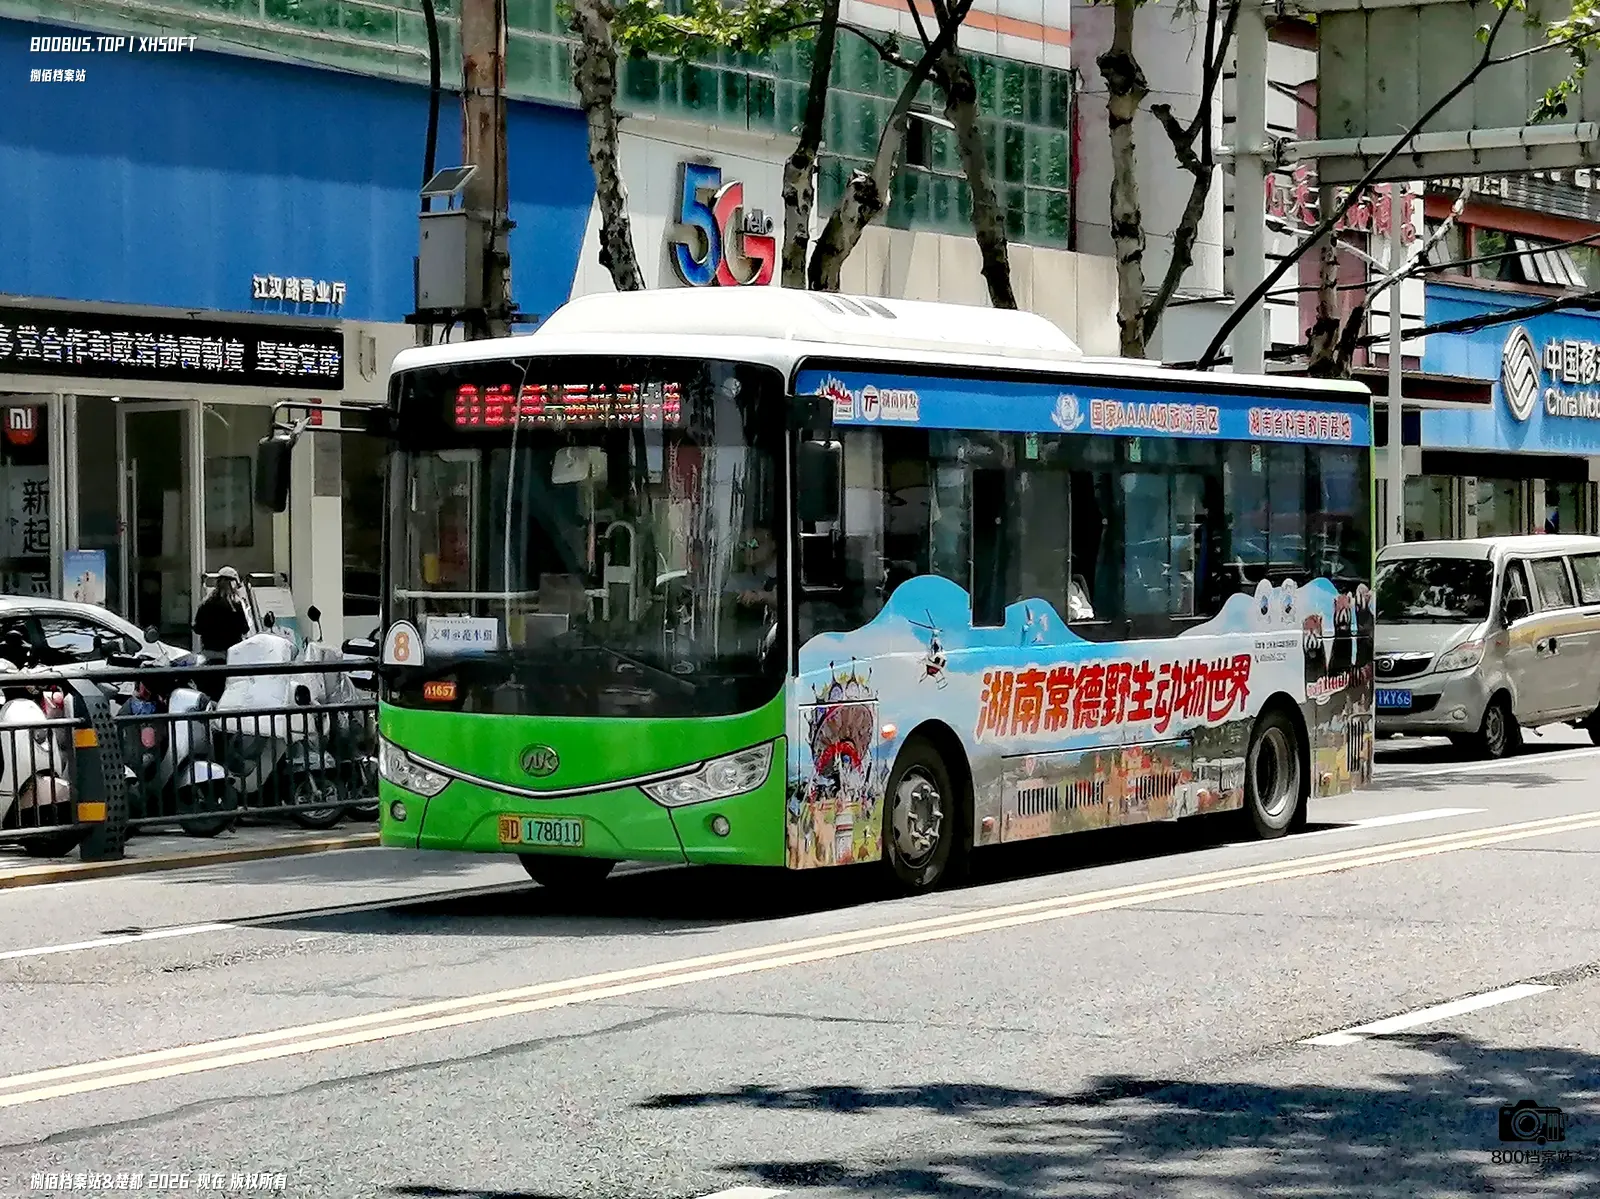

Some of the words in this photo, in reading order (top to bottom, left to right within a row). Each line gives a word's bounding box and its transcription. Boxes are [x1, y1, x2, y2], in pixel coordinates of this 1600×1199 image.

[670, 161, 776, 286] 5G
[253, 275, 346, 303] 江汉路营业厅
[1545, 337, 1600, 384] 中国移
[1091, 401, 1219, 433] 国家AAAA级旅游景区
[1545, 387, 1577, 416] China
[1249, 408, 1351, 439] 湖南省科普教育基地
[394, 631, 410, 661] 8
[976, 654, 1251, 738] 湖南常德野生动物世界
[526, 821, 582, 843] 17801D
